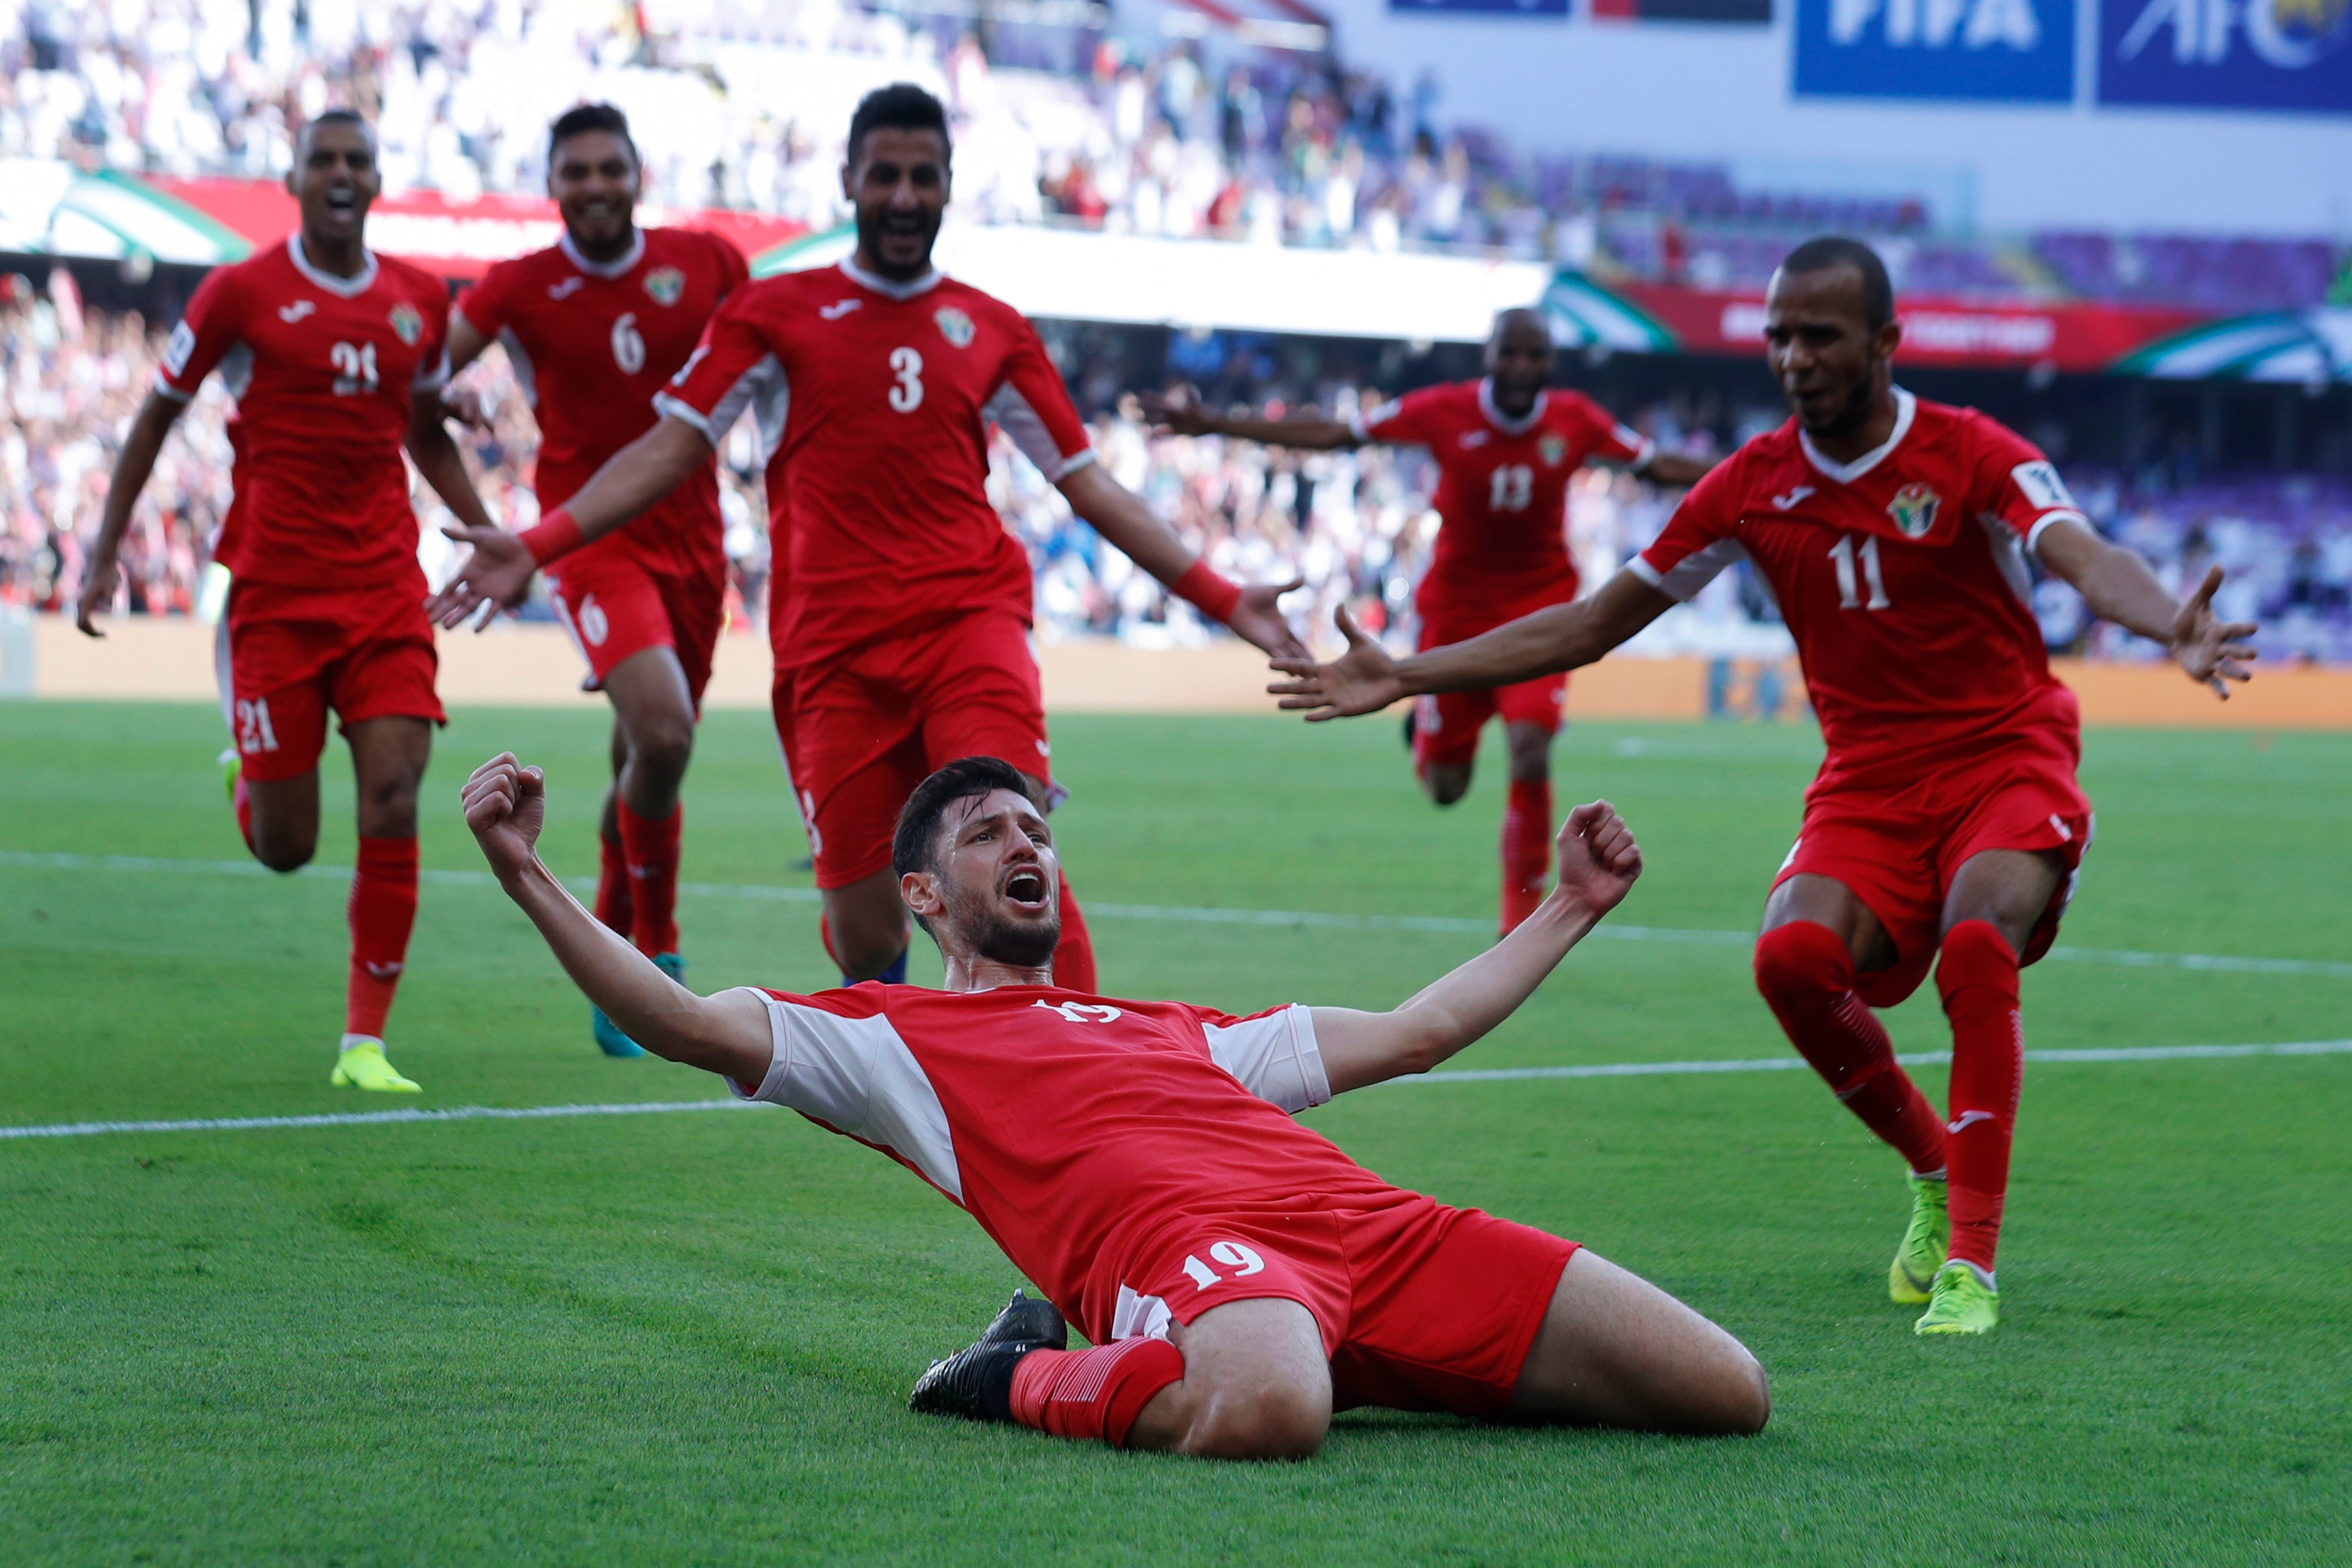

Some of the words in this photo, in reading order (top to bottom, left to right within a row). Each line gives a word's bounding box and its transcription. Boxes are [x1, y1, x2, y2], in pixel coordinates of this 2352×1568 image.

[330, 341, 380, 397] 21
[611, 312, 646, 375] 6
[888, 346, 924, 413] 3
[1490, 463, 1534, 512] 13
[1827, 532, 1891, 611] 11
[578, 593, 609, 646] 6
[236, 697, 280, 753] 21
[1030, 999, 1122, 1023] 19
[1182, 1241, 1265, 1292] 19
